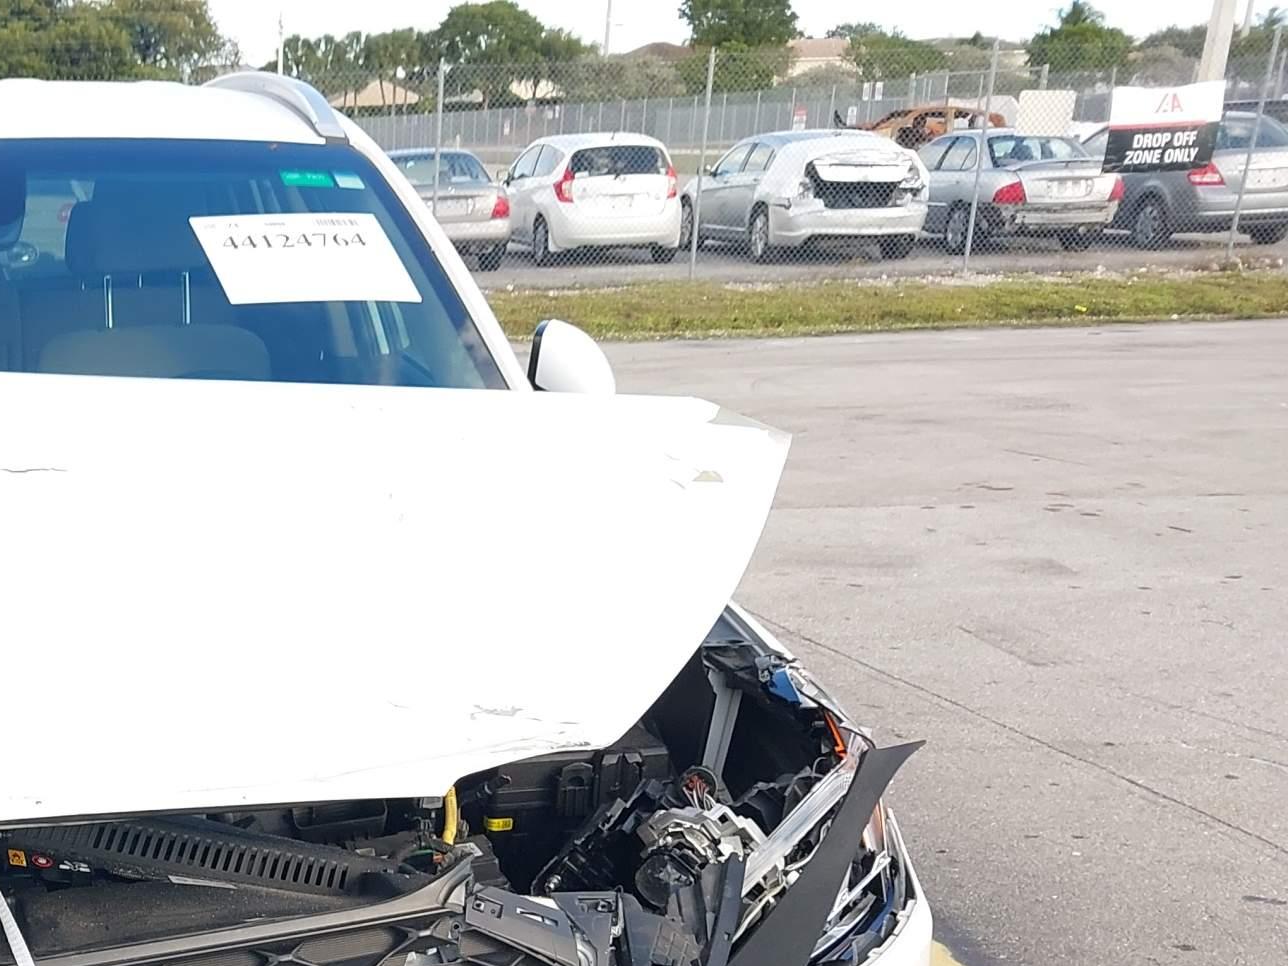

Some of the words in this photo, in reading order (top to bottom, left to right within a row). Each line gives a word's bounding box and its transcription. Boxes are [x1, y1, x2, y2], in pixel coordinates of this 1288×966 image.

[1133, 132, 1172, 148] DROP
[1173, 131, 1198, 146] OFF
[1123, 148, 1162, 165] ZONE
[1163, 147, 1199, 163] ONLY
[222, 232, 367, 250] 44124764
